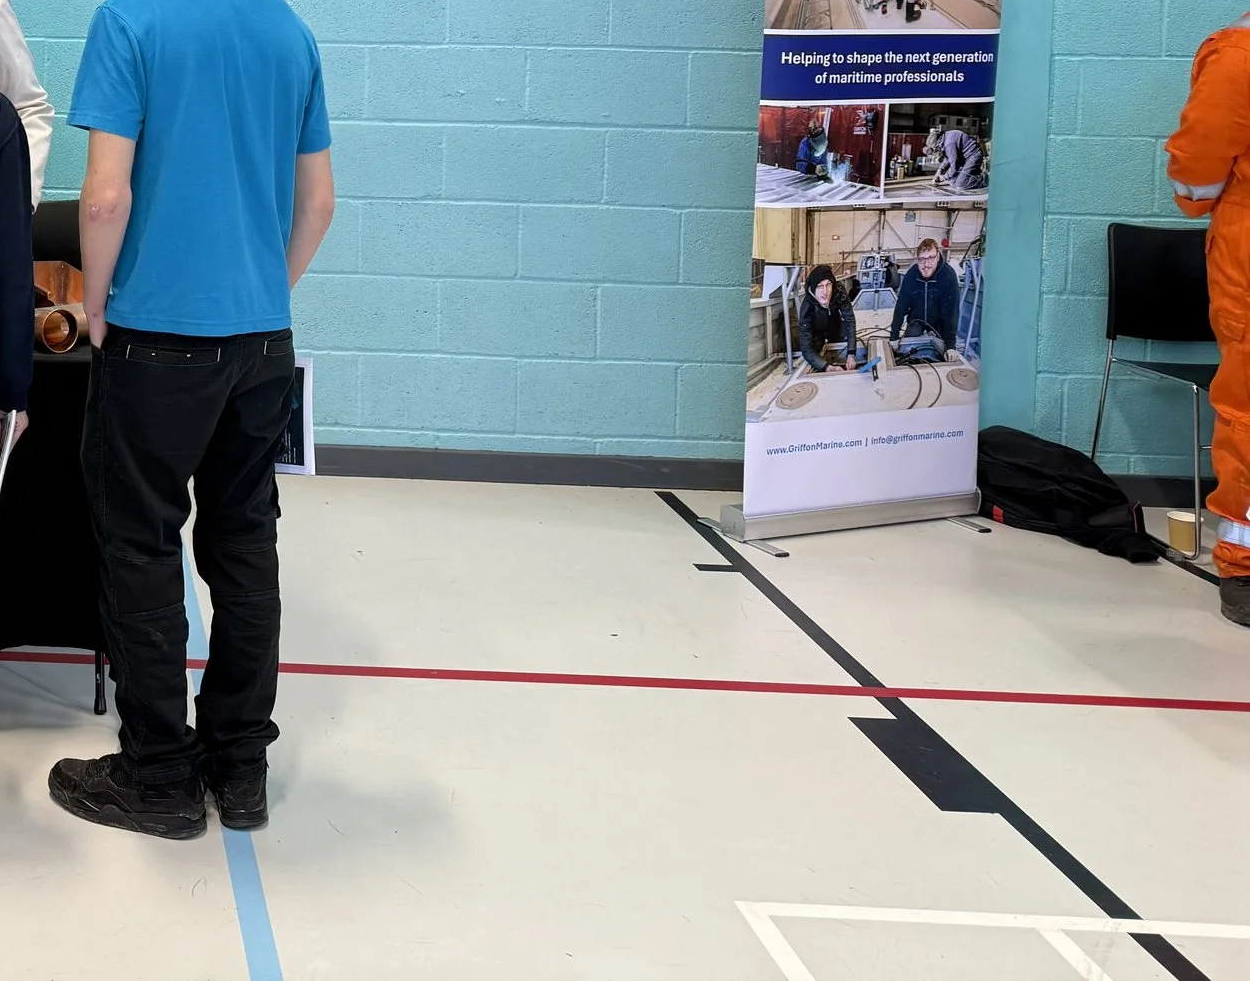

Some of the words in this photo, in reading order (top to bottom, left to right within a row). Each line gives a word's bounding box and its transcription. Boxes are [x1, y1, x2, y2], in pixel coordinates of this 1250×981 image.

[781, 51, 831, 67] Helping
[832, 52, 845, 64] to
[846, 51, 883, 66] shape
[884, 51, 904, 63] the
[905, 52, 930, 63] next
[932, 50, 994, 65] generation
[815, 71, 828, 84] of
[829, 71, 882, 84] maritime
[884, 70, 965, 86] professionals
[766, 438, 863, 456] www.GriffonMarine.com
